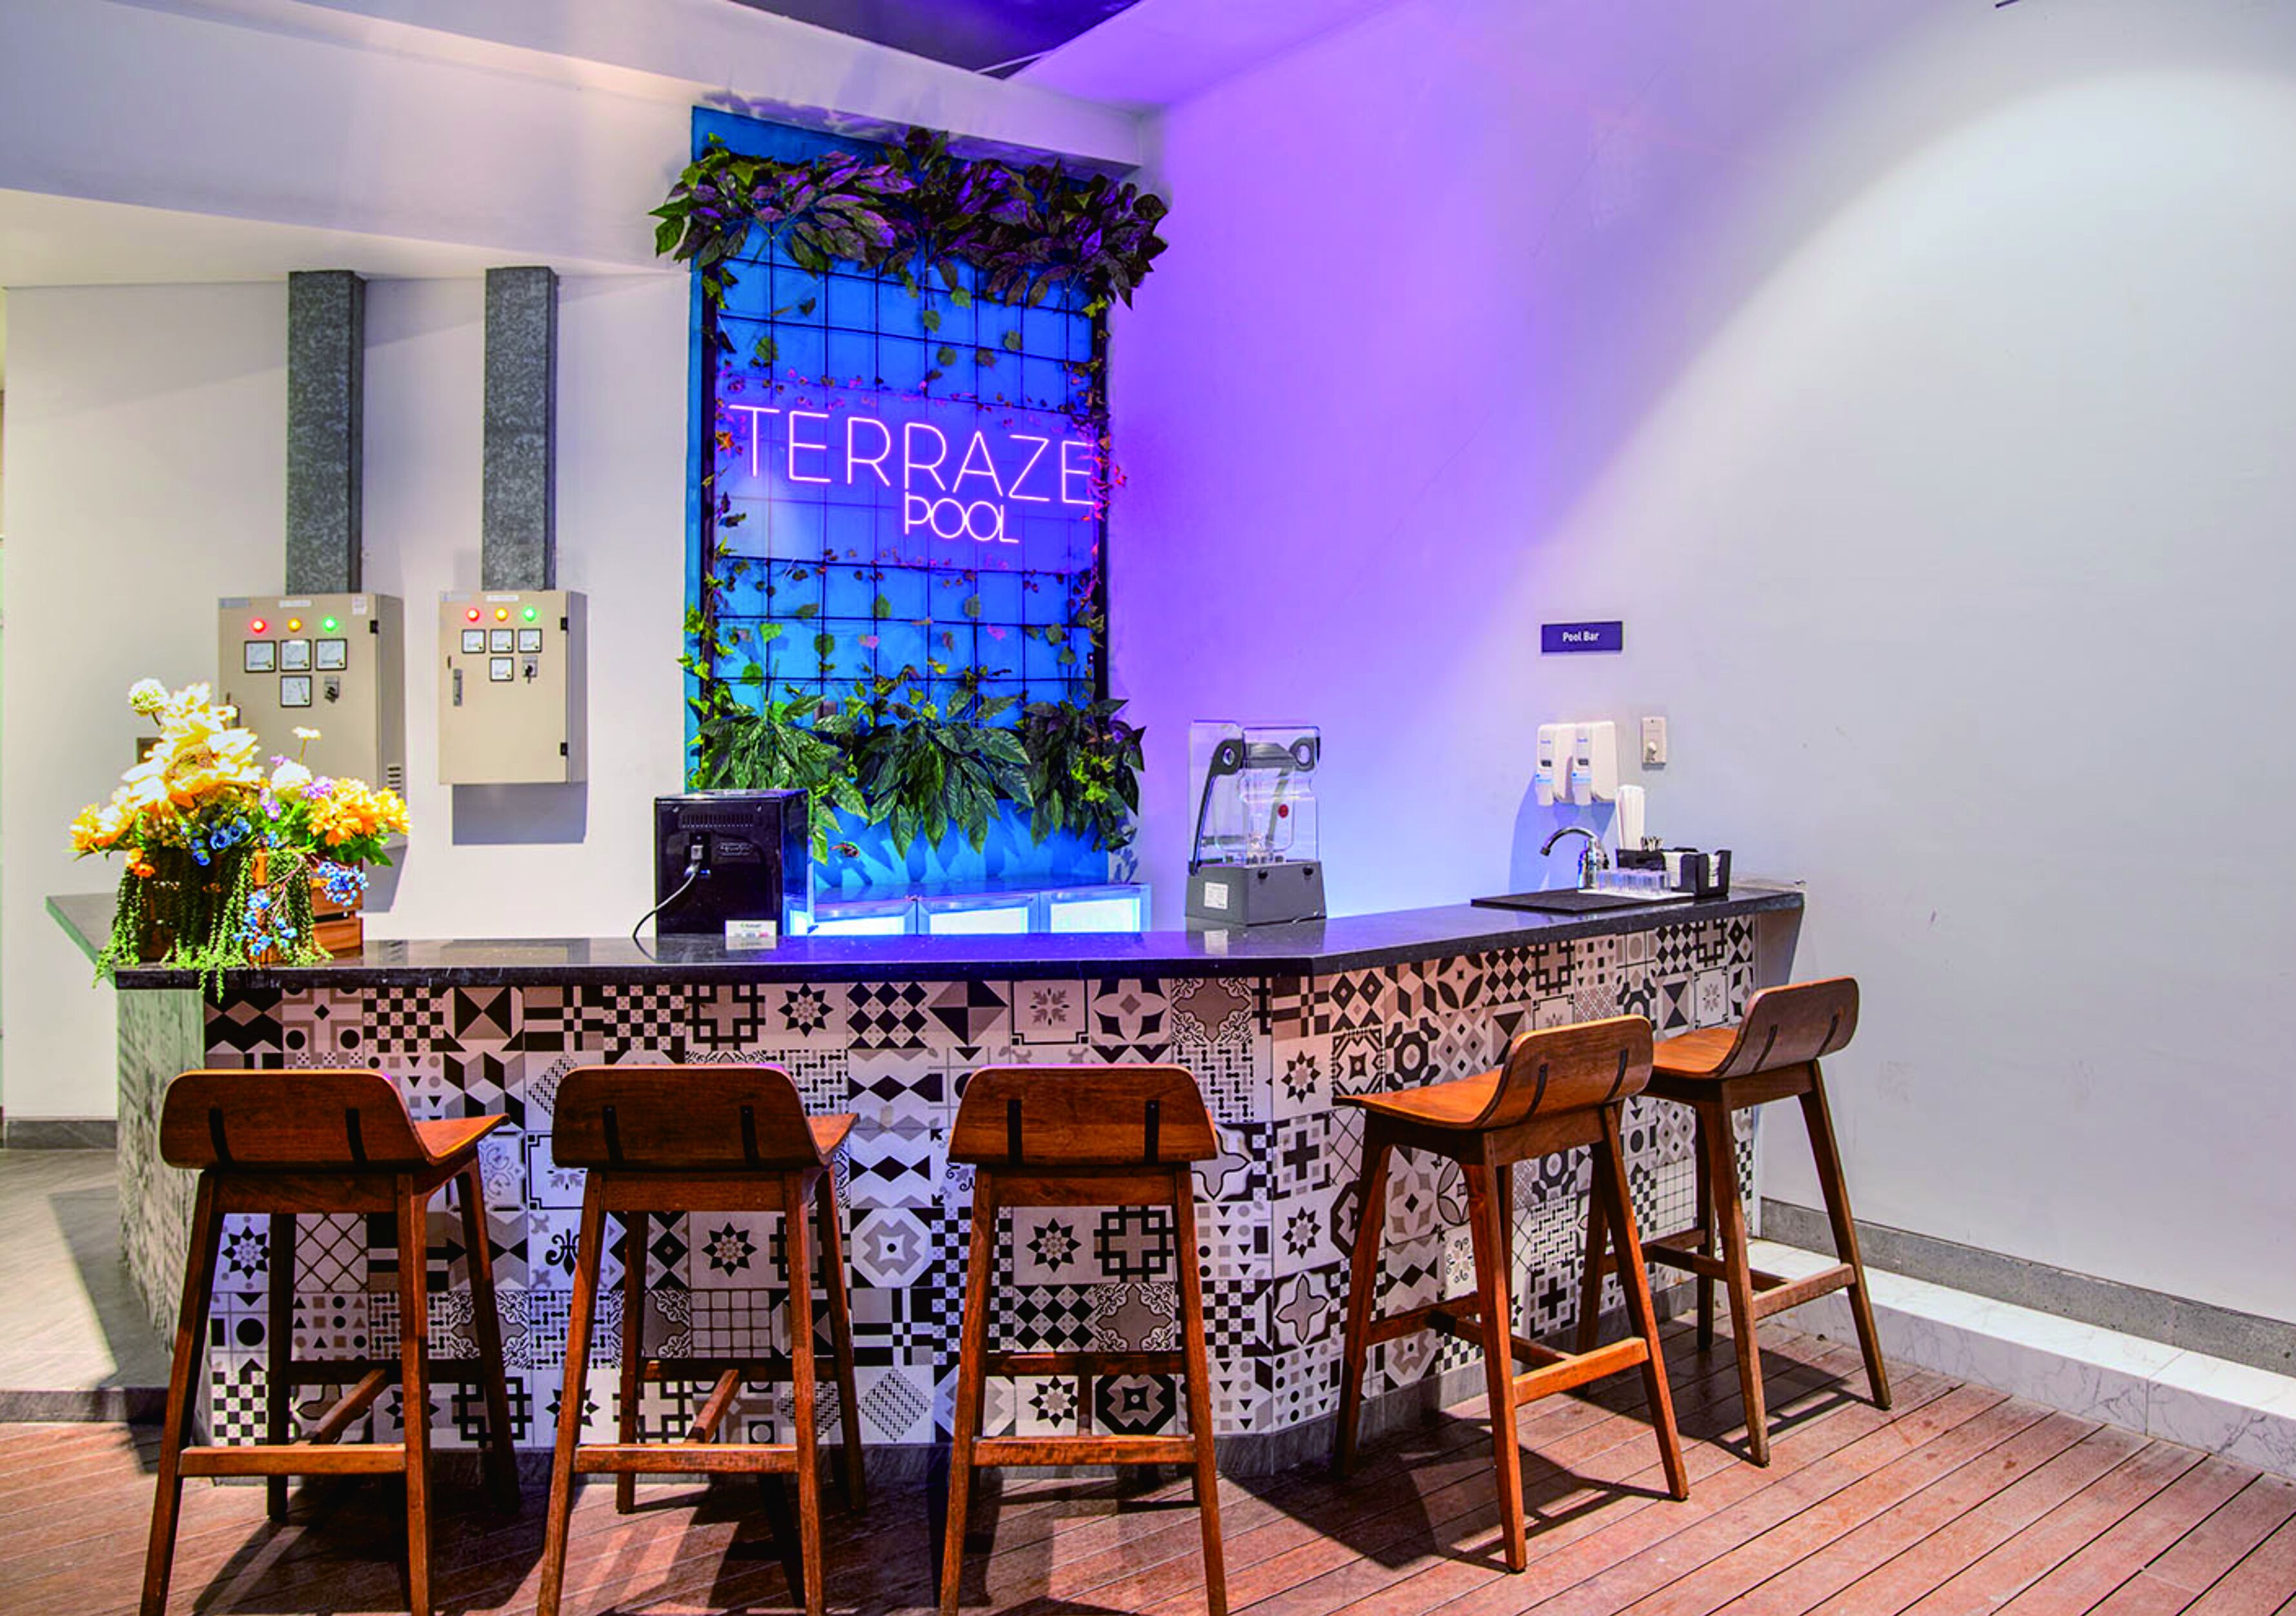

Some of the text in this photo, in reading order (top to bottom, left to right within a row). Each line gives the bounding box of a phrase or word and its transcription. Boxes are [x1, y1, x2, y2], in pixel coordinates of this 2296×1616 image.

[728, 404, 1095, 506] TERRAZE
[904, 491, 1019, 544] POOL
[1563, 630, 1600, 642] Pool Bar
